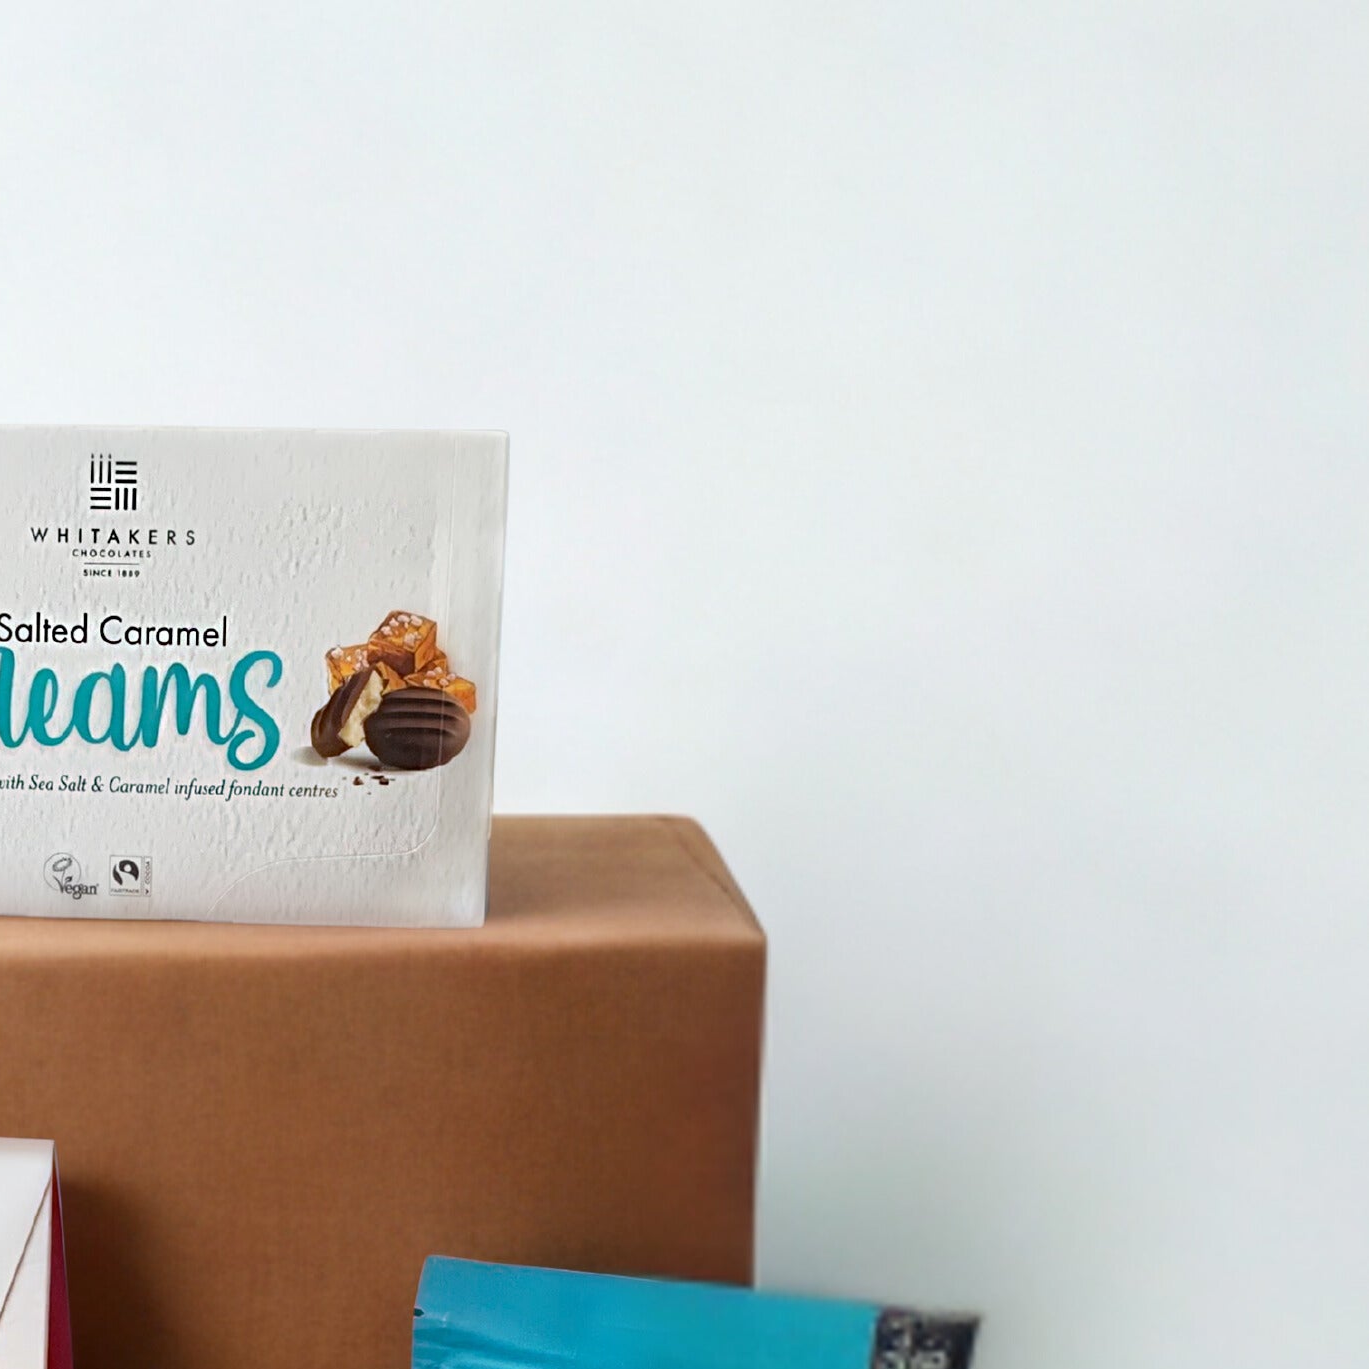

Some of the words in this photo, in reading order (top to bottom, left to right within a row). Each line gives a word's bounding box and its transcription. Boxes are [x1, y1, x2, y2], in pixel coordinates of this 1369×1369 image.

[30, 528, 195, 546] WHITAKERS
[72, 549, 151, 558] CHOCOLATES
[83, 569, 112, 577] SINCE
[99, 614, 228, 647] Caramel
[28, 774, 54, 792] Sea
[58, 774, 88, 793] Salt
[91, 776, 105, 792] &
[109, 776, 170, 796] Caramel
[174, 779, 226, 799] infused
[225, 778, 286, 803] fondant
[289, 783, 339, 799] centres
[52, 875, 98, 900] Vegan
